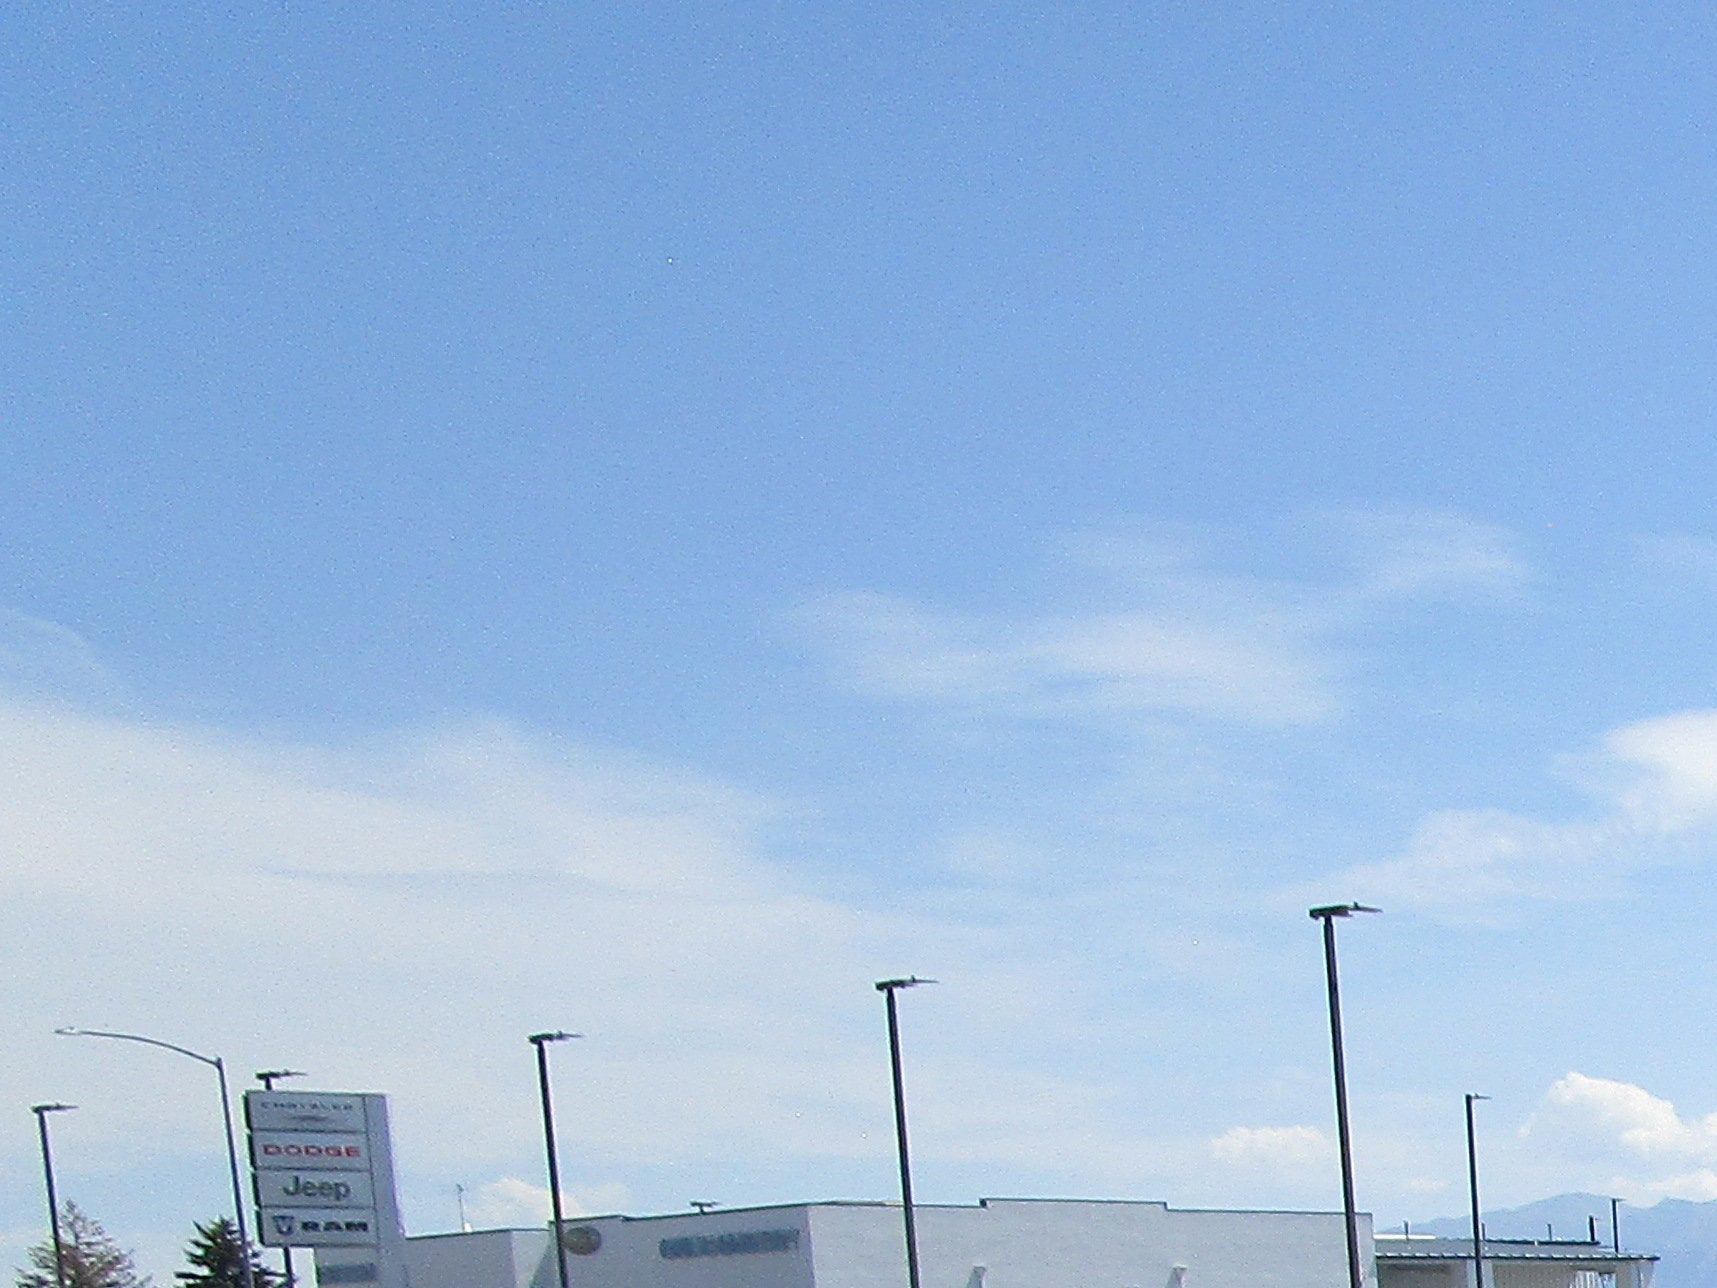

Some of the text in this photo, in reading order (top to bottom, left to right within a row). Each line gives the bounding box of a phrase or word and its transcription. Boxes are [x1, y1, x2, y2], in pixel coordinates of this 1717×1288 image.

[262, 1143, 361, 1157] DODGE
[282, 1175, 350, 1200] Jeep
[301, 1220, 368, 1232] RAM
